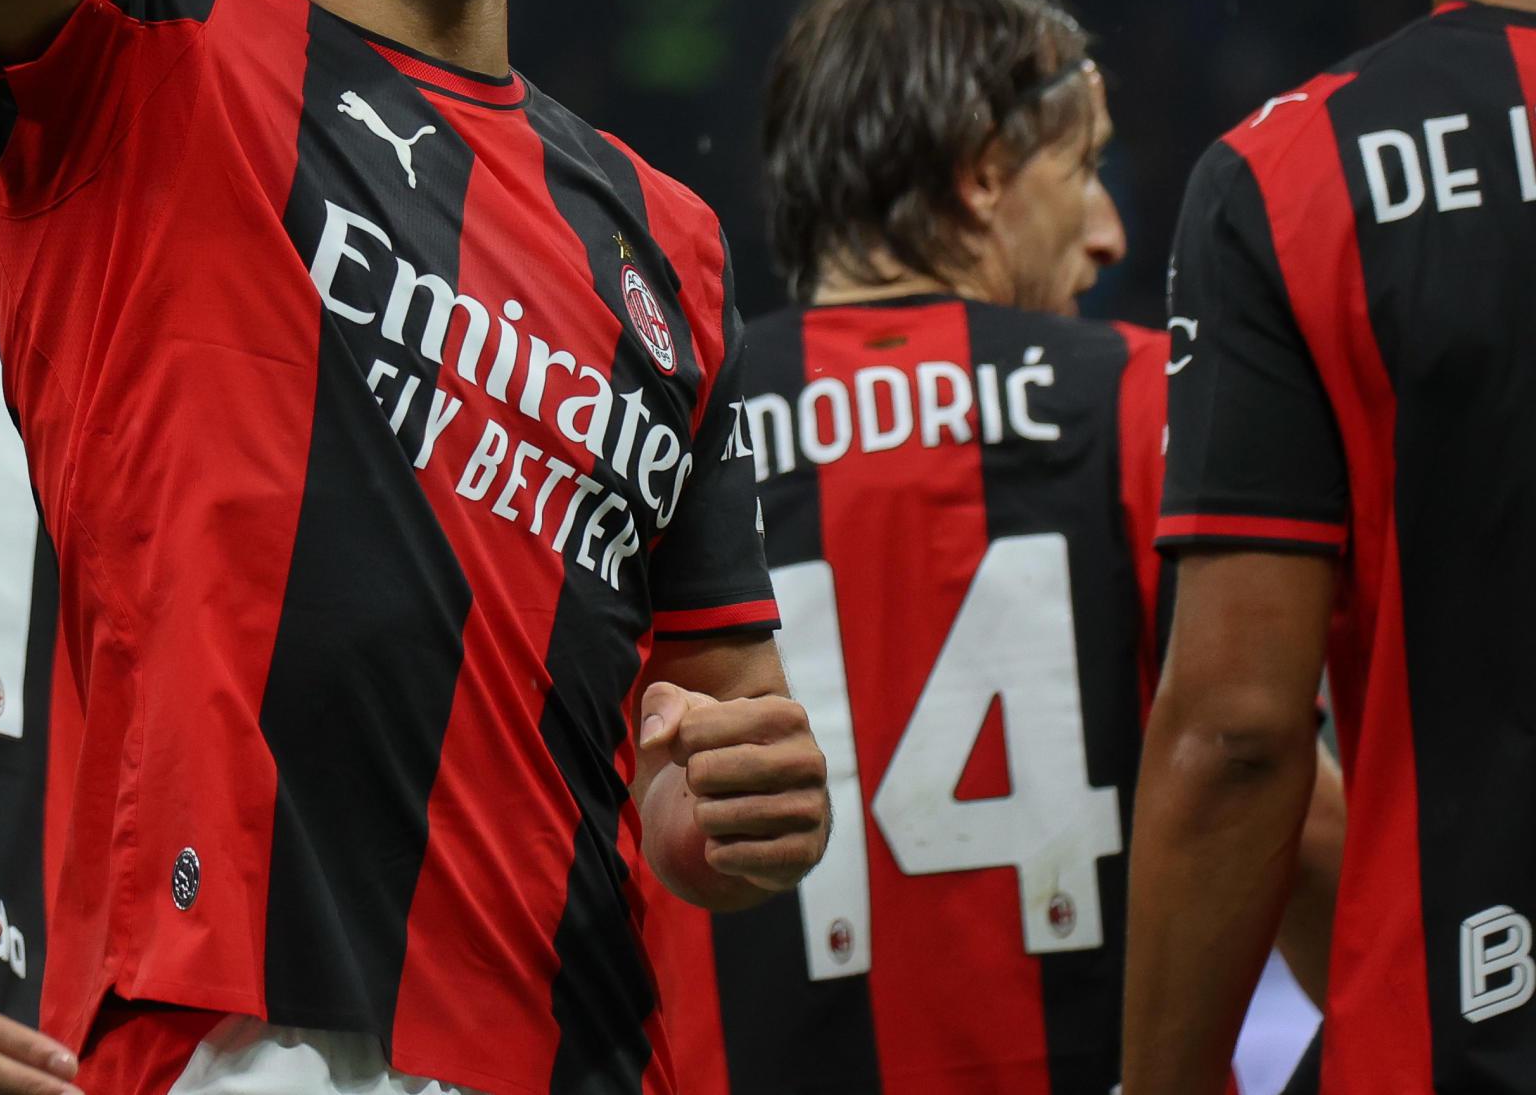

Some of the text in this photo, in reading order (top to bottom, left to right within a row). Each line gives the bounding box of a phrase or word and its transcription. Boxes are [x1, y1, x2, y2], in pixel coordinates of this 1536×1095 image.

[1357, 112, 1482, 225] DE
[309, 198, 693, 529] Emirates
[454, 419, 639, 591] BETTER
[767, 531, 1123, 983] 14
